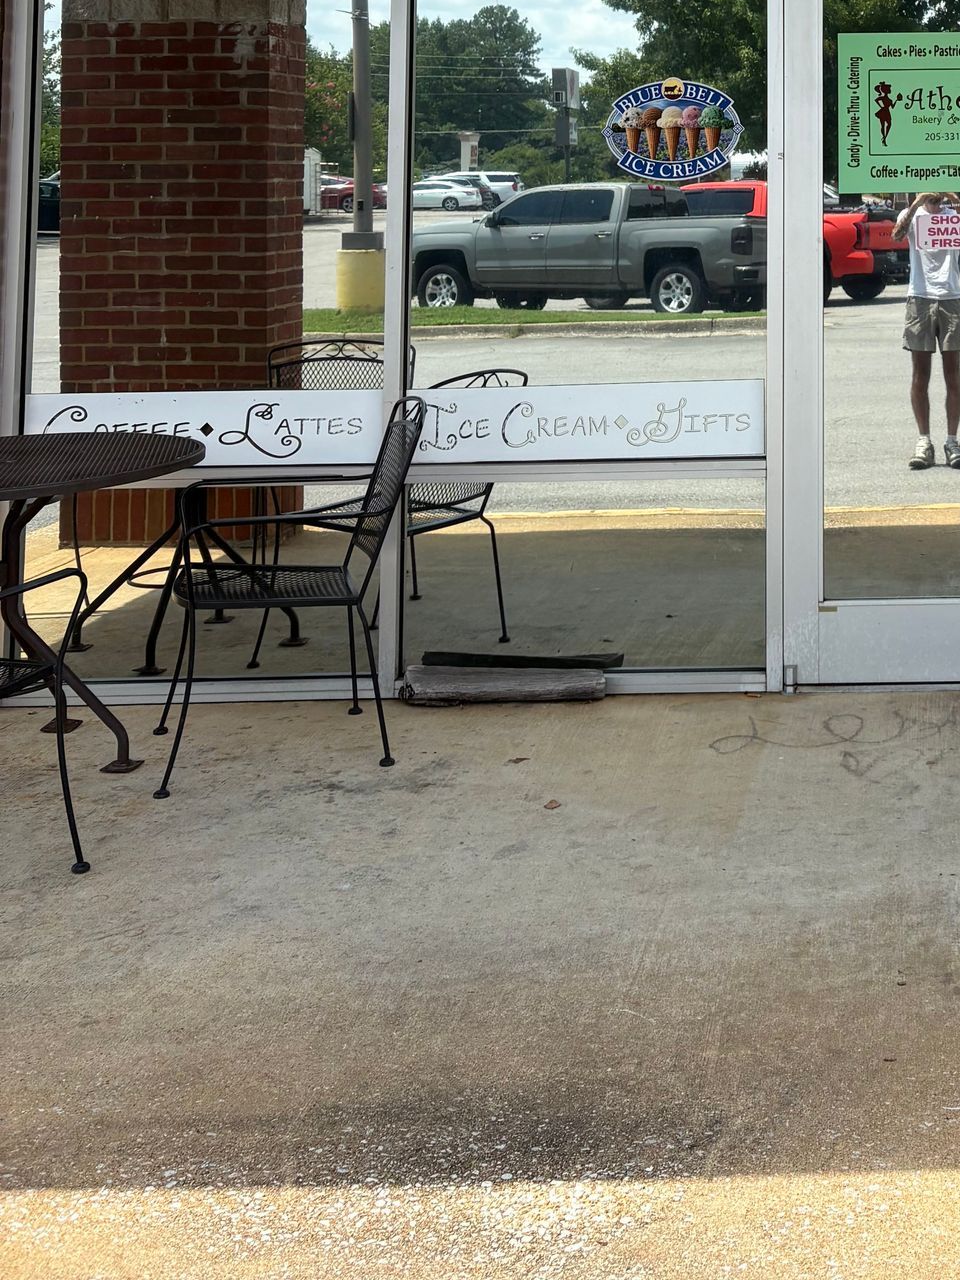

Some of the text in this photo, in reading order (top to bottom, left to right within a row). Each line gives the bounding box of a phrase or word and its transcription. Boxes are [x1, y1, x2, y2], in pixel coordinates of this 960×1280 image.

[876, 45, 902, 58] Cakes
[909, 45, 927, 57] Pies
[619, 85, 727, 112] BLUE BELL
[847, 56, 863, 168] Candy Drive-Thru Catering
[912, 115, 942, 125] Bakery
[947, 113, 960, 125] &
[624, 151, 723, 178] ICE CREAM
[870, 165, 899, 179] Coffee
[905, 166, 941, 180] Frappes
[218, 402, 363, 458] LATTES
[419, 397, 751, 451] ICE CREAM GIFTS
